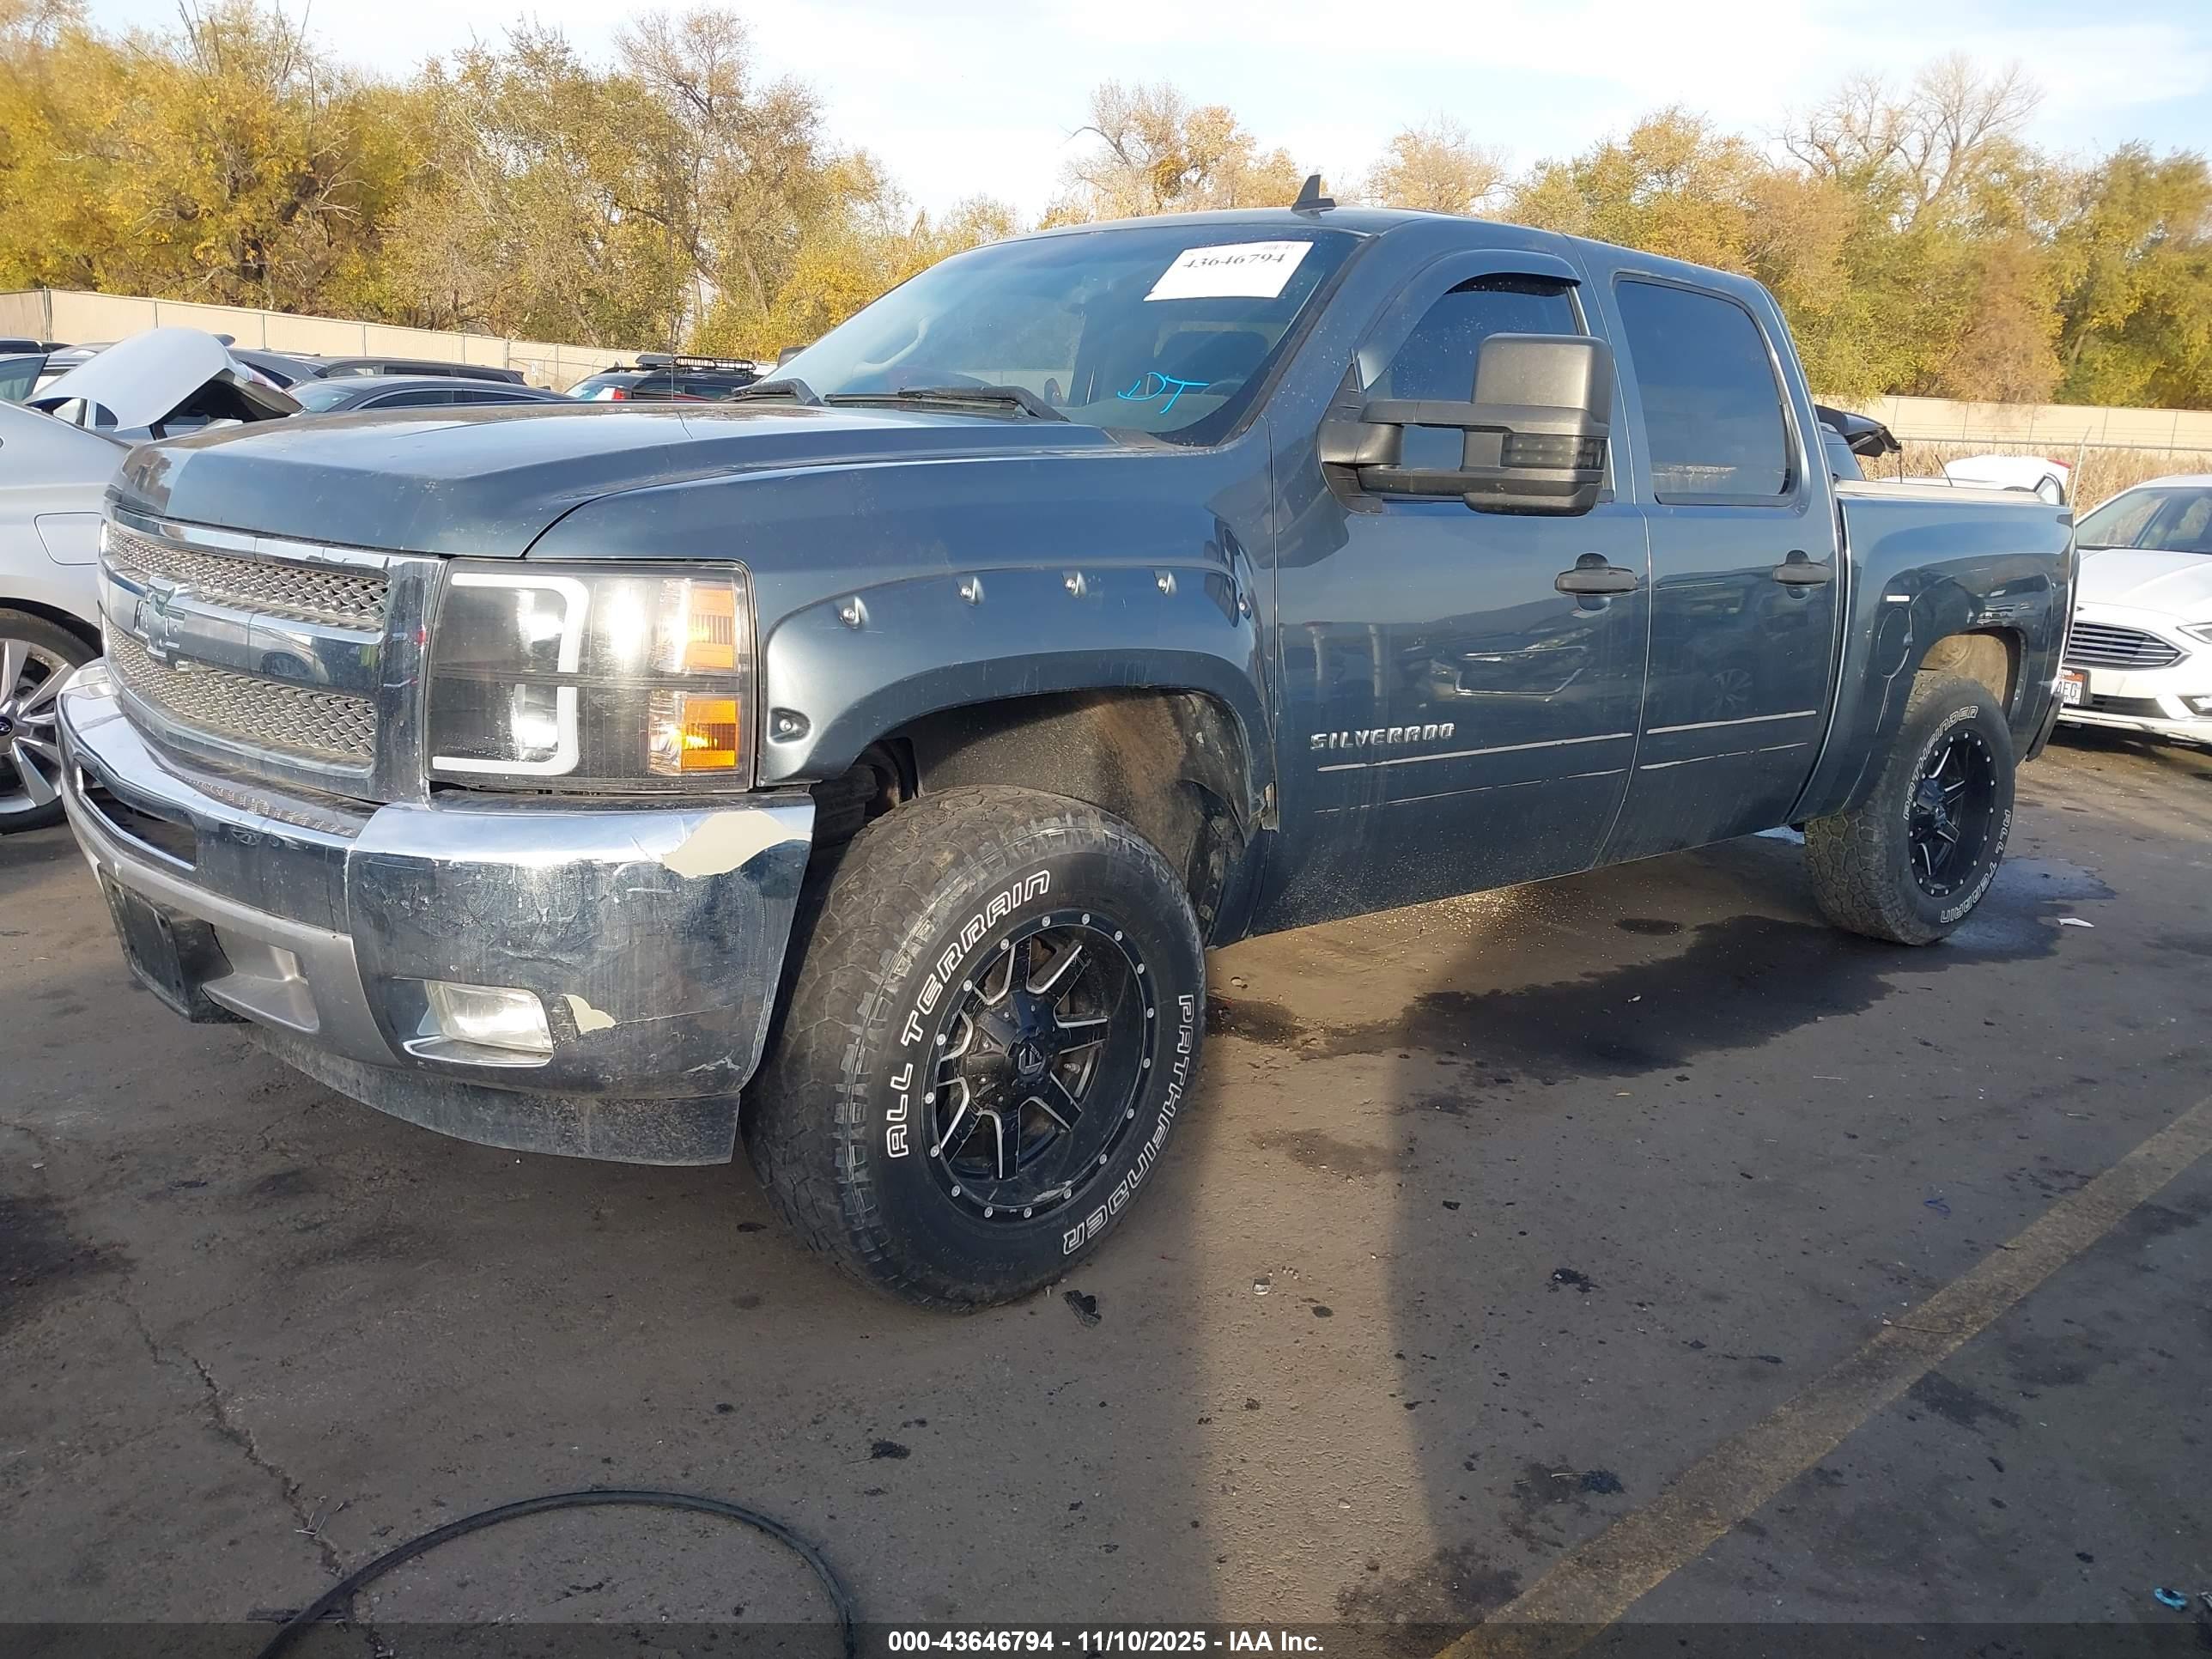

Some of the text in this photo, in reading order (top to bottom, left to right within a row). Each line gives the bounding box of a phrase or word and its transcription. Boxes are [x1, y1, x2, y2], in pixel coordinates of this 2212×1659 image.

[1183, 253, 1286, 269] 43646794
[1310, 722, 1455, 750] SILVERADO
[1903, 705, 1979, 821] PATHFINDER
[1940, 809, 2012, 924] ALL TERRAIN
[886, 869, 1051, 1159] ALL TERRAIN
[1062, 994, 1195, 1256] PATHFINDER
